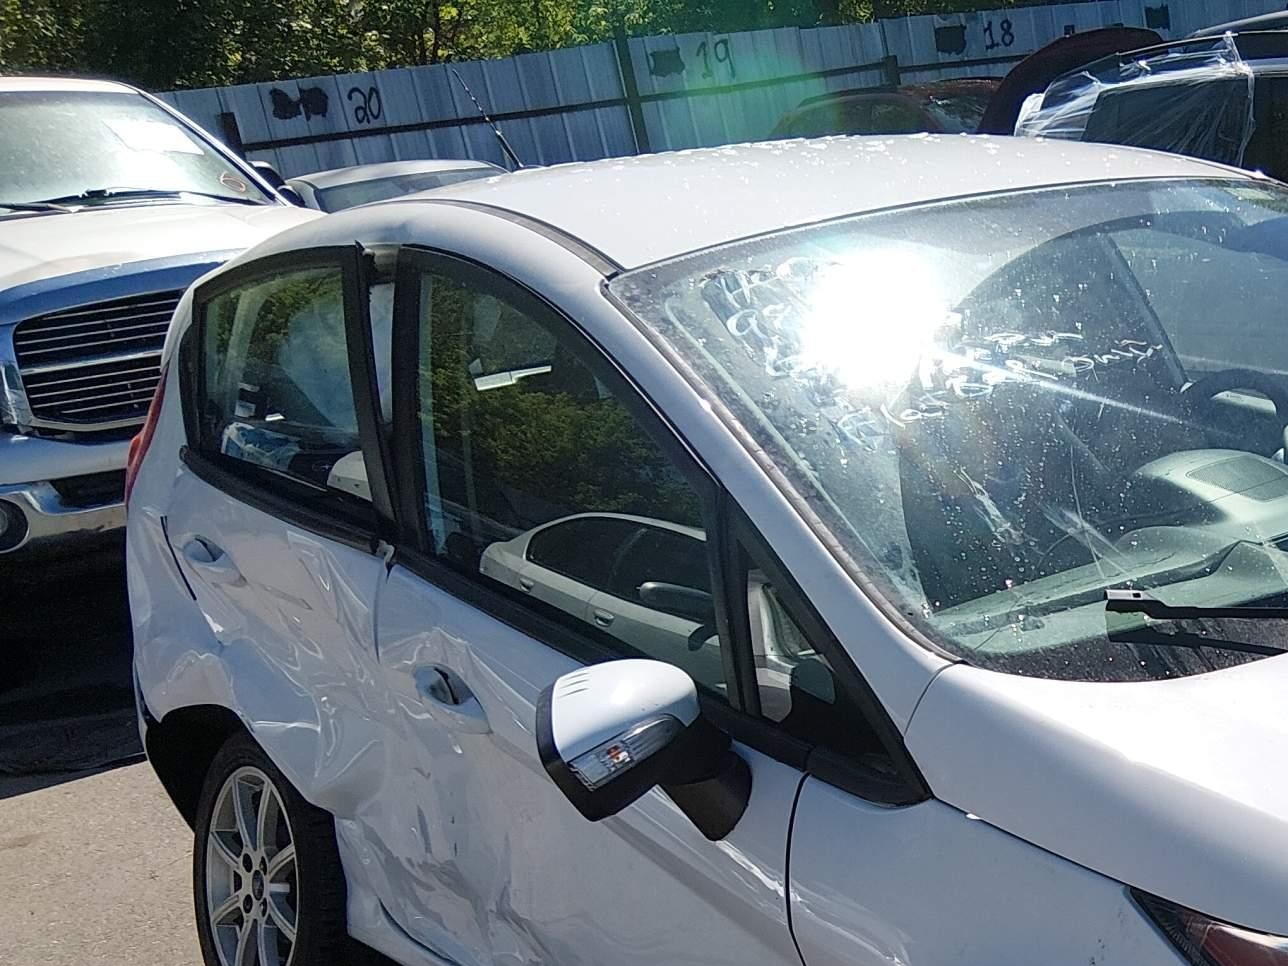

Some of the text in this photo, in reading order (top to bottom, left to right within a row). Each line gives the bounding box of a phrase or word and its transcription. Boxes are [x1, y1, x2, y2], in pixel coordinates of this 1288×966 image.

[983, 19, 1015, 51] 18
[696, 39, 736, 80] 19
[347, 86, 382, 124] 20
